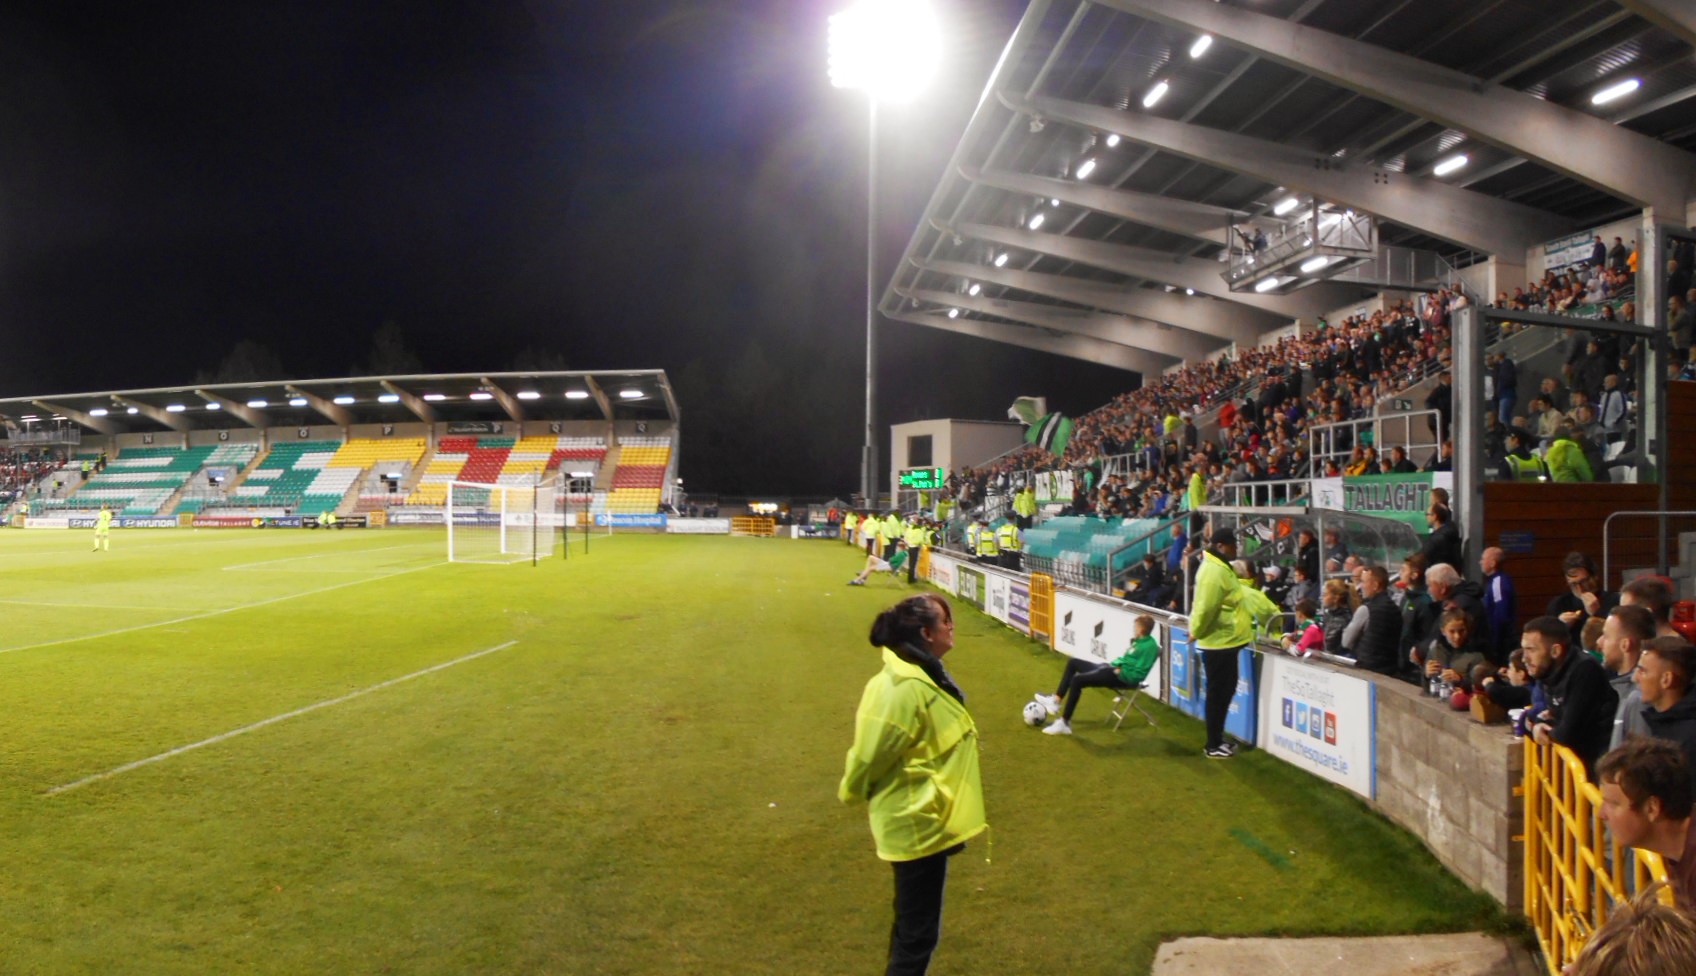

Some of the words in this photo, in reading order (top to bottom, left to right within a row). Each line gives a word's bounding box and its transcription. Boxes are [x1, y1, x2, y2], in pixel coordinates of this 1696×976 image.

[1344, 482, 1429, 512] TALLAGHT
[136, 518, 176, 527] HYUNDAI
[1273, 732, 1349, 775] www.thesquare.ie
